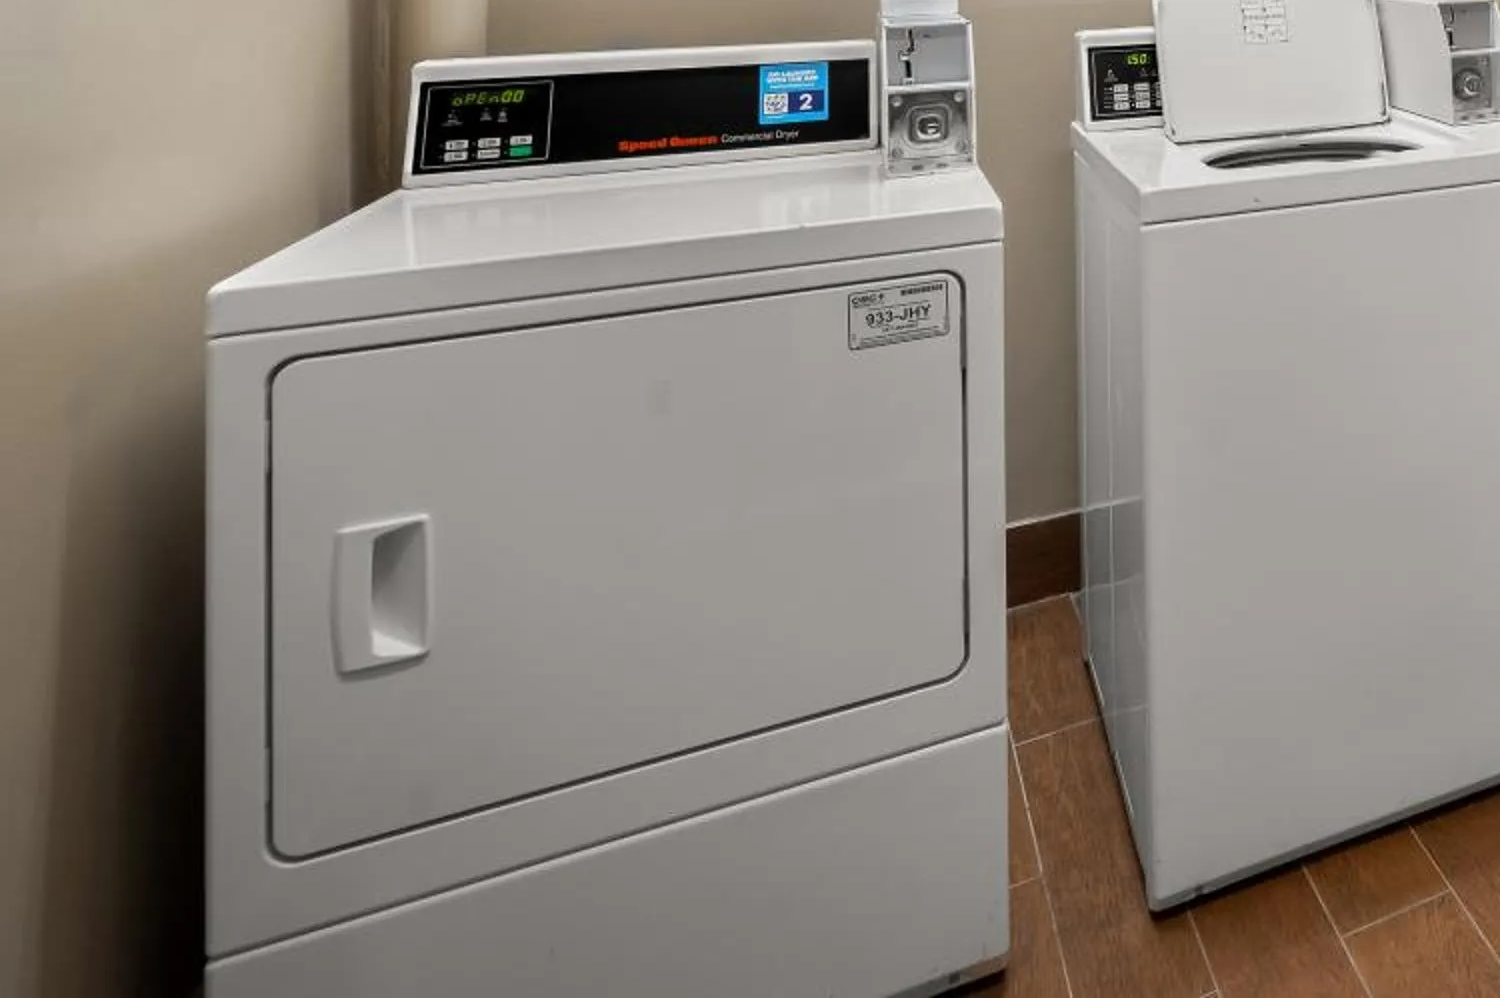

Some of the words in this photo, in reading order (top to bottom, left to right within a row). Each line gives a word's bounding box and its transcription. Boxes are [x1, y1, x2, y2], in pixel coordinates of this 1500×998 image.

[799, 93, 813, 111] 2
[775, 129, 800, 141] Dryer
[865, 303, 932, 326] 933-JHY
